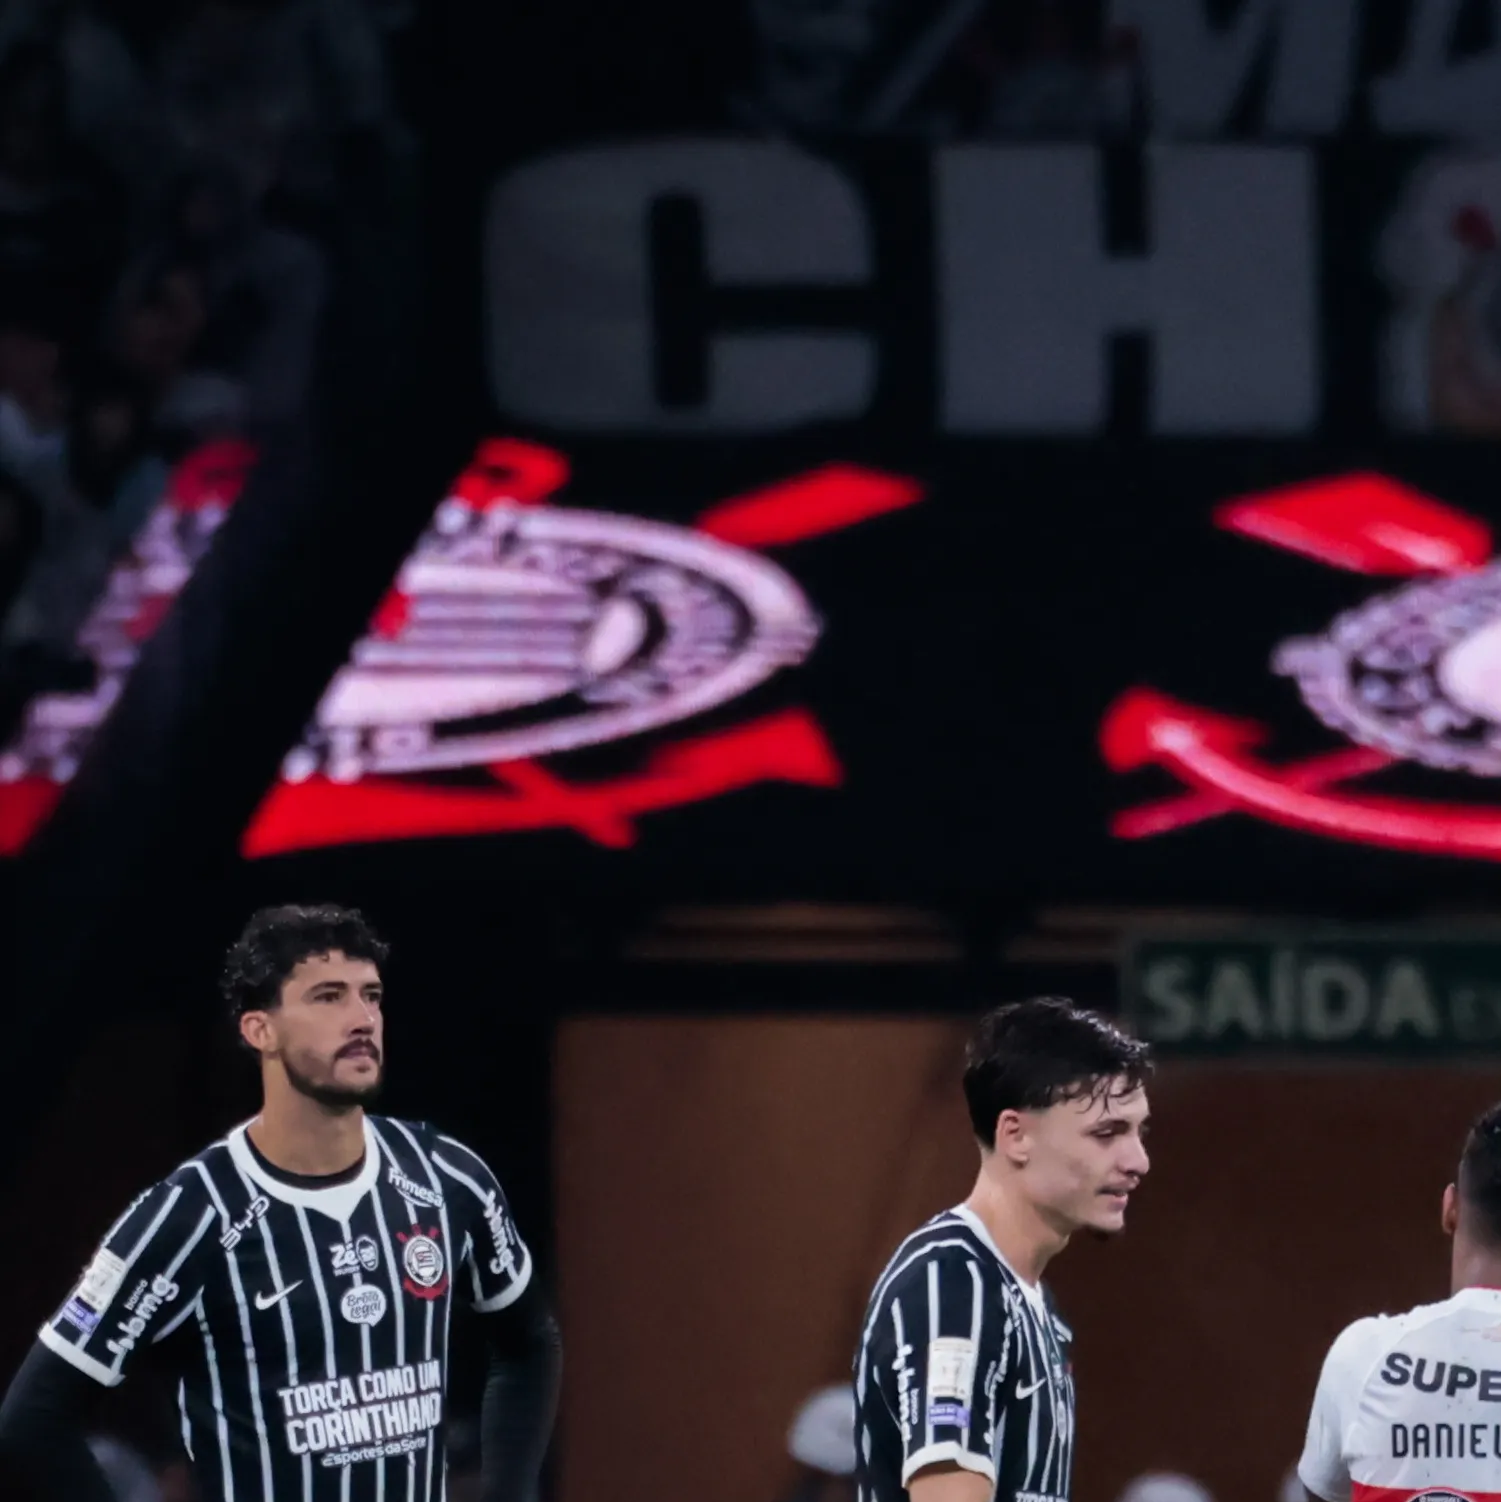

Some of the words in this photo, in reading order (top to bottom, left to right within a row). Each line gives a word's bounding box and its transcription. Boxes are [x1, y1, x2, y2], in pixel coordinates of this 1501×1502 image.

[1143, 946, 1440, 1042] SAÍDA
[220, 1195, 270, 1250] BYD
[329, 1242, 359, 1269] Zé
[117, 1274, 180, 1338] bmg
[124, 1279, 148, 1310] banco
[277, 1376, 356, 1416] TORÇA
[358, 1366, 417, 1402] COMO
[418, 1359, 441, 1391] UM
[286, 1392, 442, 1455] CORINTHIANO
